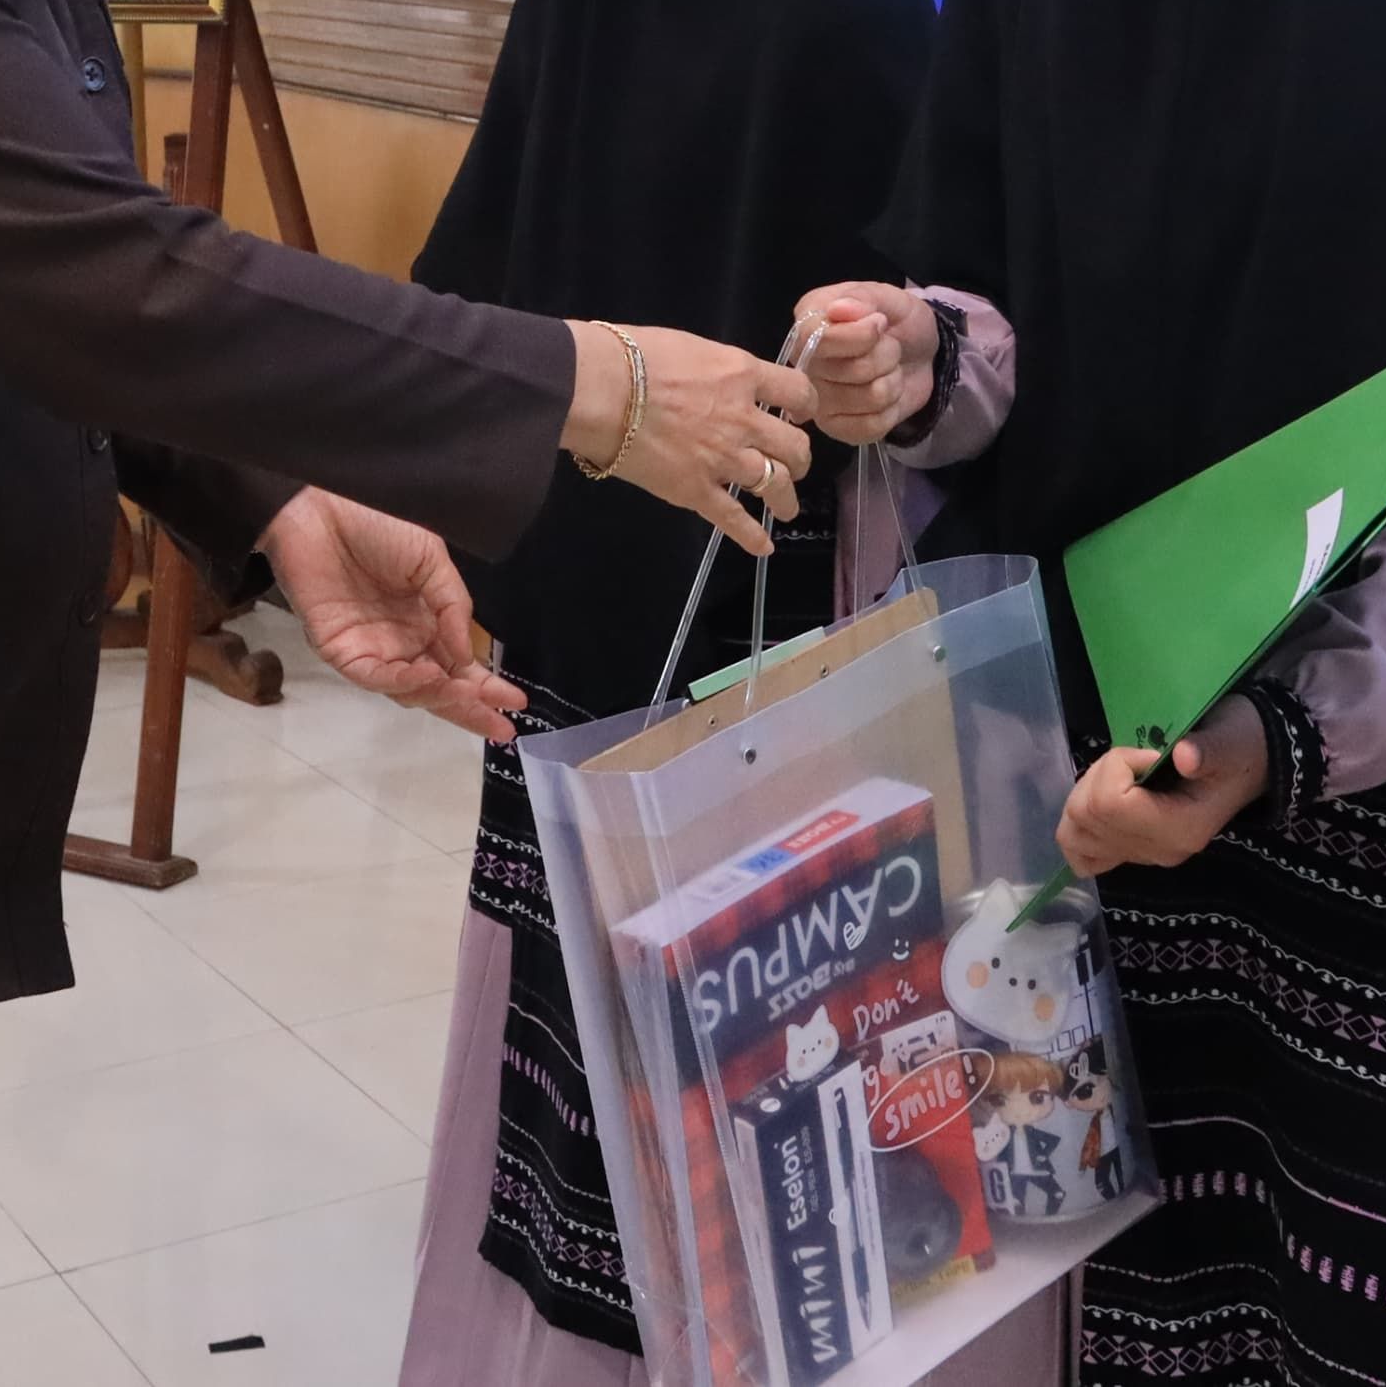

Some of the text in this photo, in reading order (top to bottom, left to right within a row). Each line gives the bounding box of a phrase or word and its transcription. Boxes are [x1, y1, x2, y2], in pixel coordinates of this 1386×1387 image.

[692, 855, 922, 1033] CAMPUS
[853, 979, 919, 1043] Don't
[781, 1134, 808, 1231] Eselon
